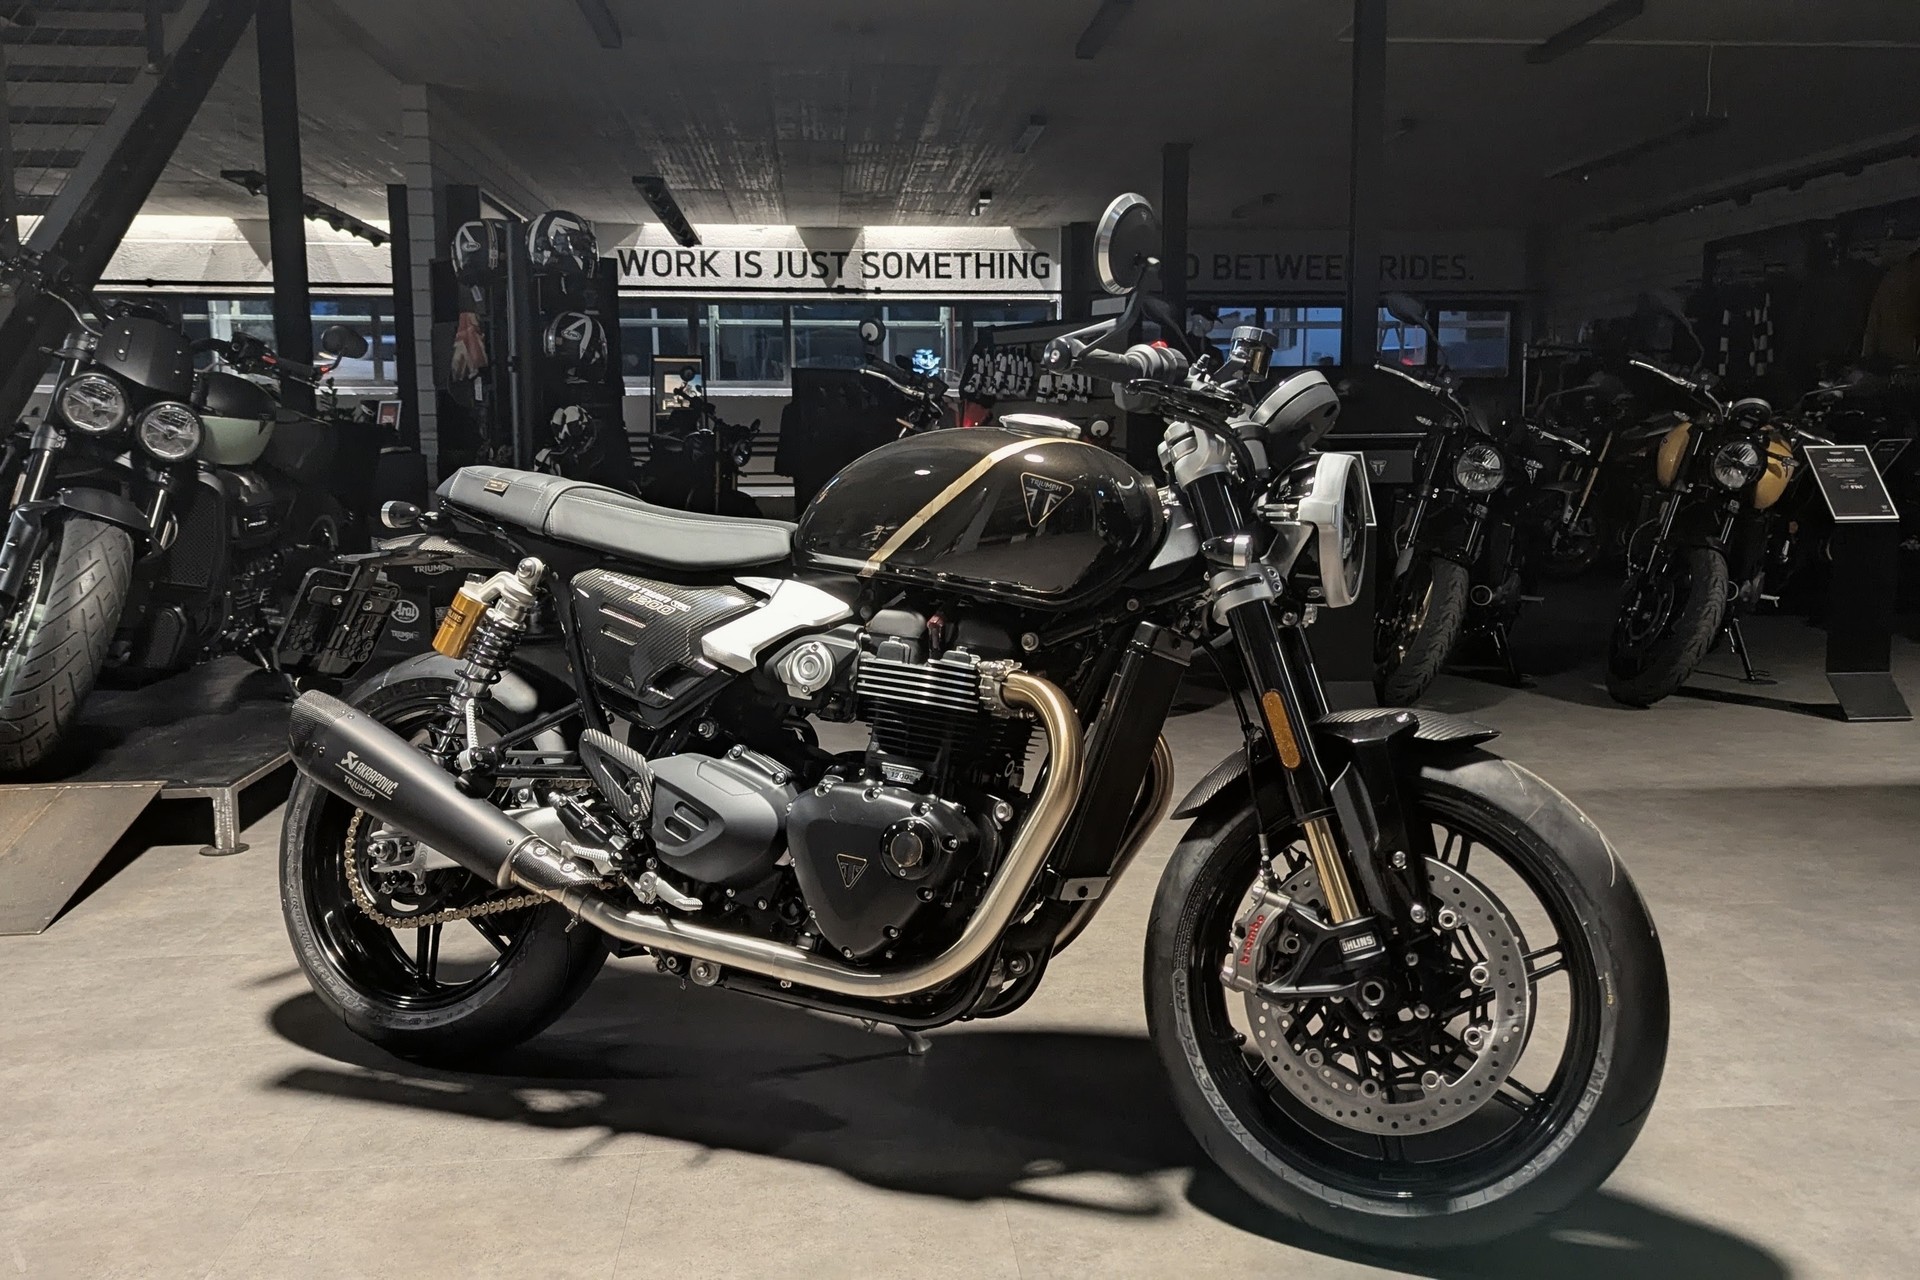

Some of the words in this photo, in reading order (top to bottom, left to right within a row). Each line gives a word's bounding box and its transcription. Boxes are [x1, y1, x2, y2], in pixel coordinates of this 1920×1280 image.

[617, 249, 721, 278] WORK
[735, 250, 763, 279] IS
[773, 250, 851, 279] JUST
[861, 251, 1050, 280] SOMETHING
[1213, 253, 1347, 281] BETWEE
[1379, 254, 1474, 281] RIDES.
[1030, 477, 1062, 492] TRIUMPH
[391, 601, 417, 618] Arai
[627, 592, 676, 616] 1200
[343, 774, 376, 800] TRIUMPH
[1238, 914, 1265, 966] brembo
